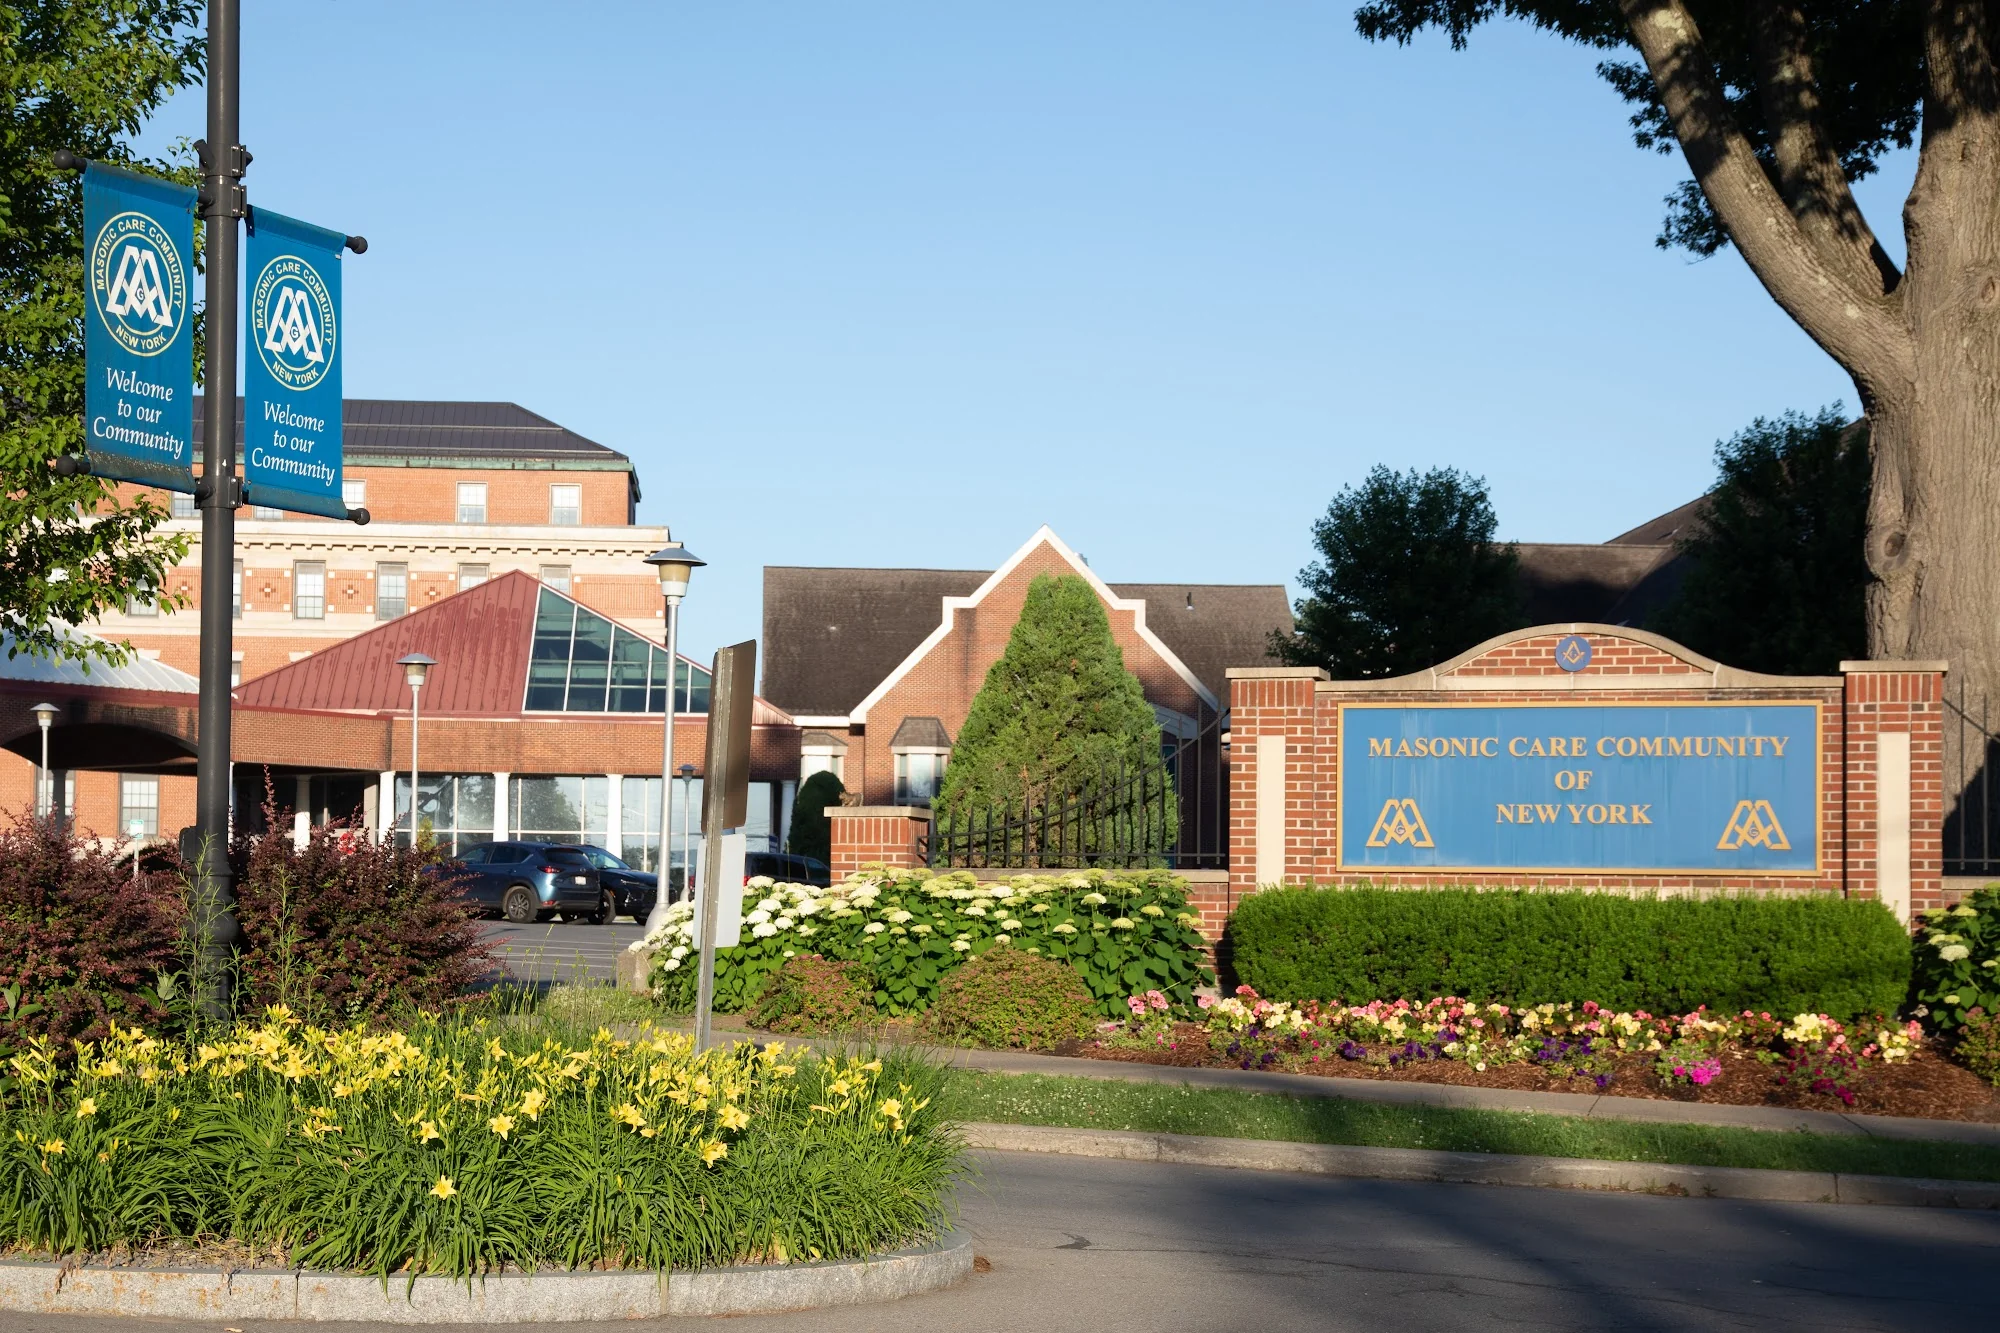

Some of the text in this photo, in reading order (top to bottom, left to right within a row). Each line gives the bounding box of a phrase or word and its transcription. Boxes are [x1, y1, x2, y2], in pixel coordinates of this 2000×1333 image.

[96, 219, 182, 308] MASONIC CARE COMMUNITY
[136, 288, 144, 300] G
[256, 262, 332, 345] MASONIC CARE COMMUNITY
[116, 325, 167, 349] NEW YORK
[290, 326, 299, 338] G
[106, 367, 174, 402] Welcome
[272, 361, 319, 385] NEW YORK
[117, 398, 162, 424] to our
[263, 400, 325, 432] Welcome
[93, 416, 184, 460] Community
[273, 429, 315, 453] to our
[252, 447, 336, 487] Community
[1368, 736, 1790, 758] MASONIC CARE COMMUNITY
[1554, 770, 1593, 791] OF
[1495, 804, 1653, 825] NEW YORK
